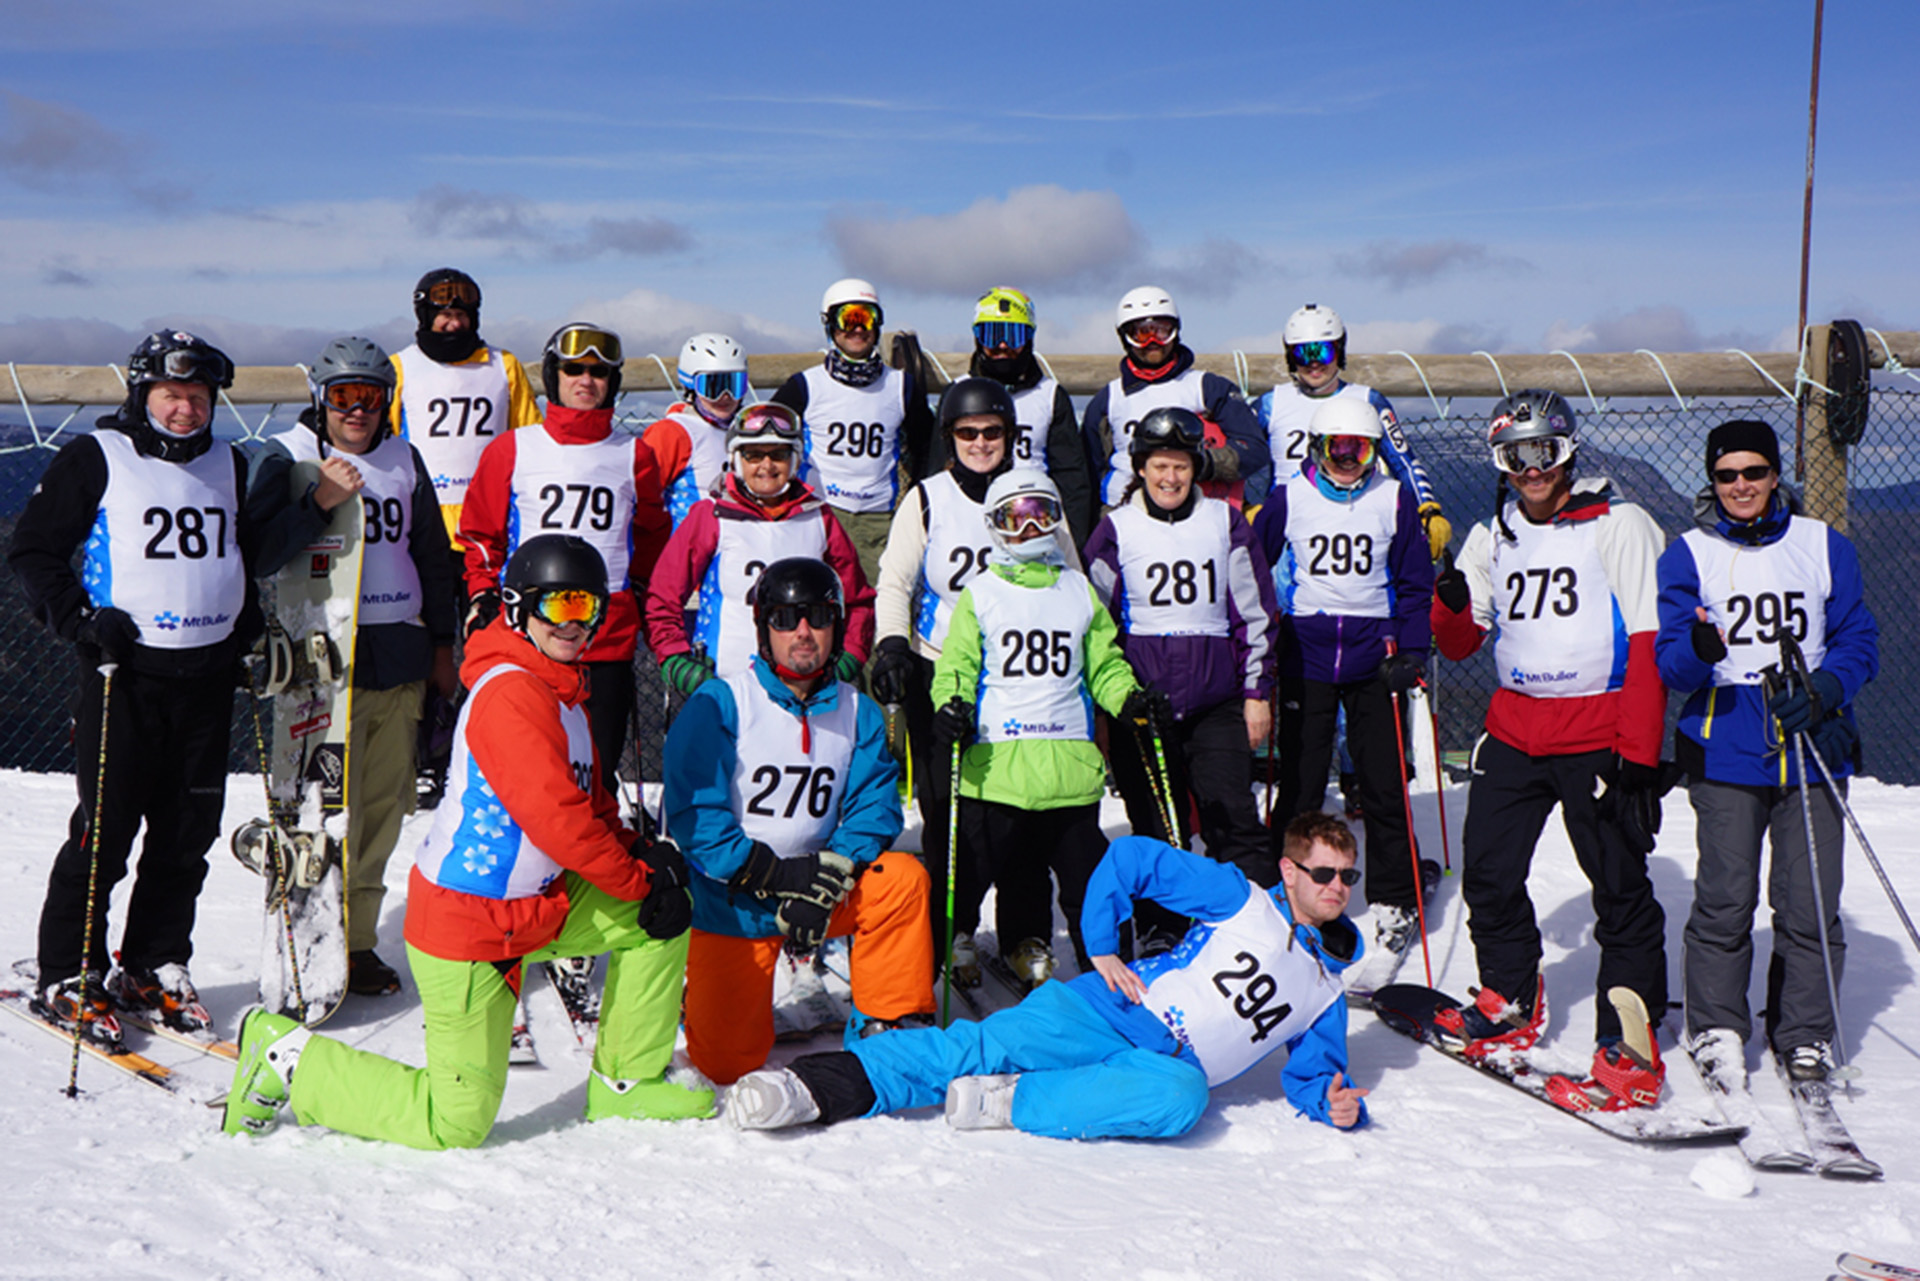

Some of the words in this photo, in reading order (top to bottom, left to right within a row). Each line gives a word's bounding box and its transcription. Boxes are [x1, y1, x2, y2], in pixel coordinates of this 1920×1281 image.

[429, 397, 494, 438] 272
[828, 422, 885, 459] 296
[1381, 413, 1405, 450] FILA
[364, 496, 404, 544] 89
[540, 484, 614, 531] 279
[144, 507, 227, 560] 287
[1310, 534, 1373, 576] 293
[1147, 558, 1217, 607] 281
[1507, 567, 1577, 621] 273
[1727, 591, 1808, 646] 295
[1003, 629, 1071, 678] 285
[748, 765, 837, 820] 276
[1213, 950, 1293, 1045] 294
